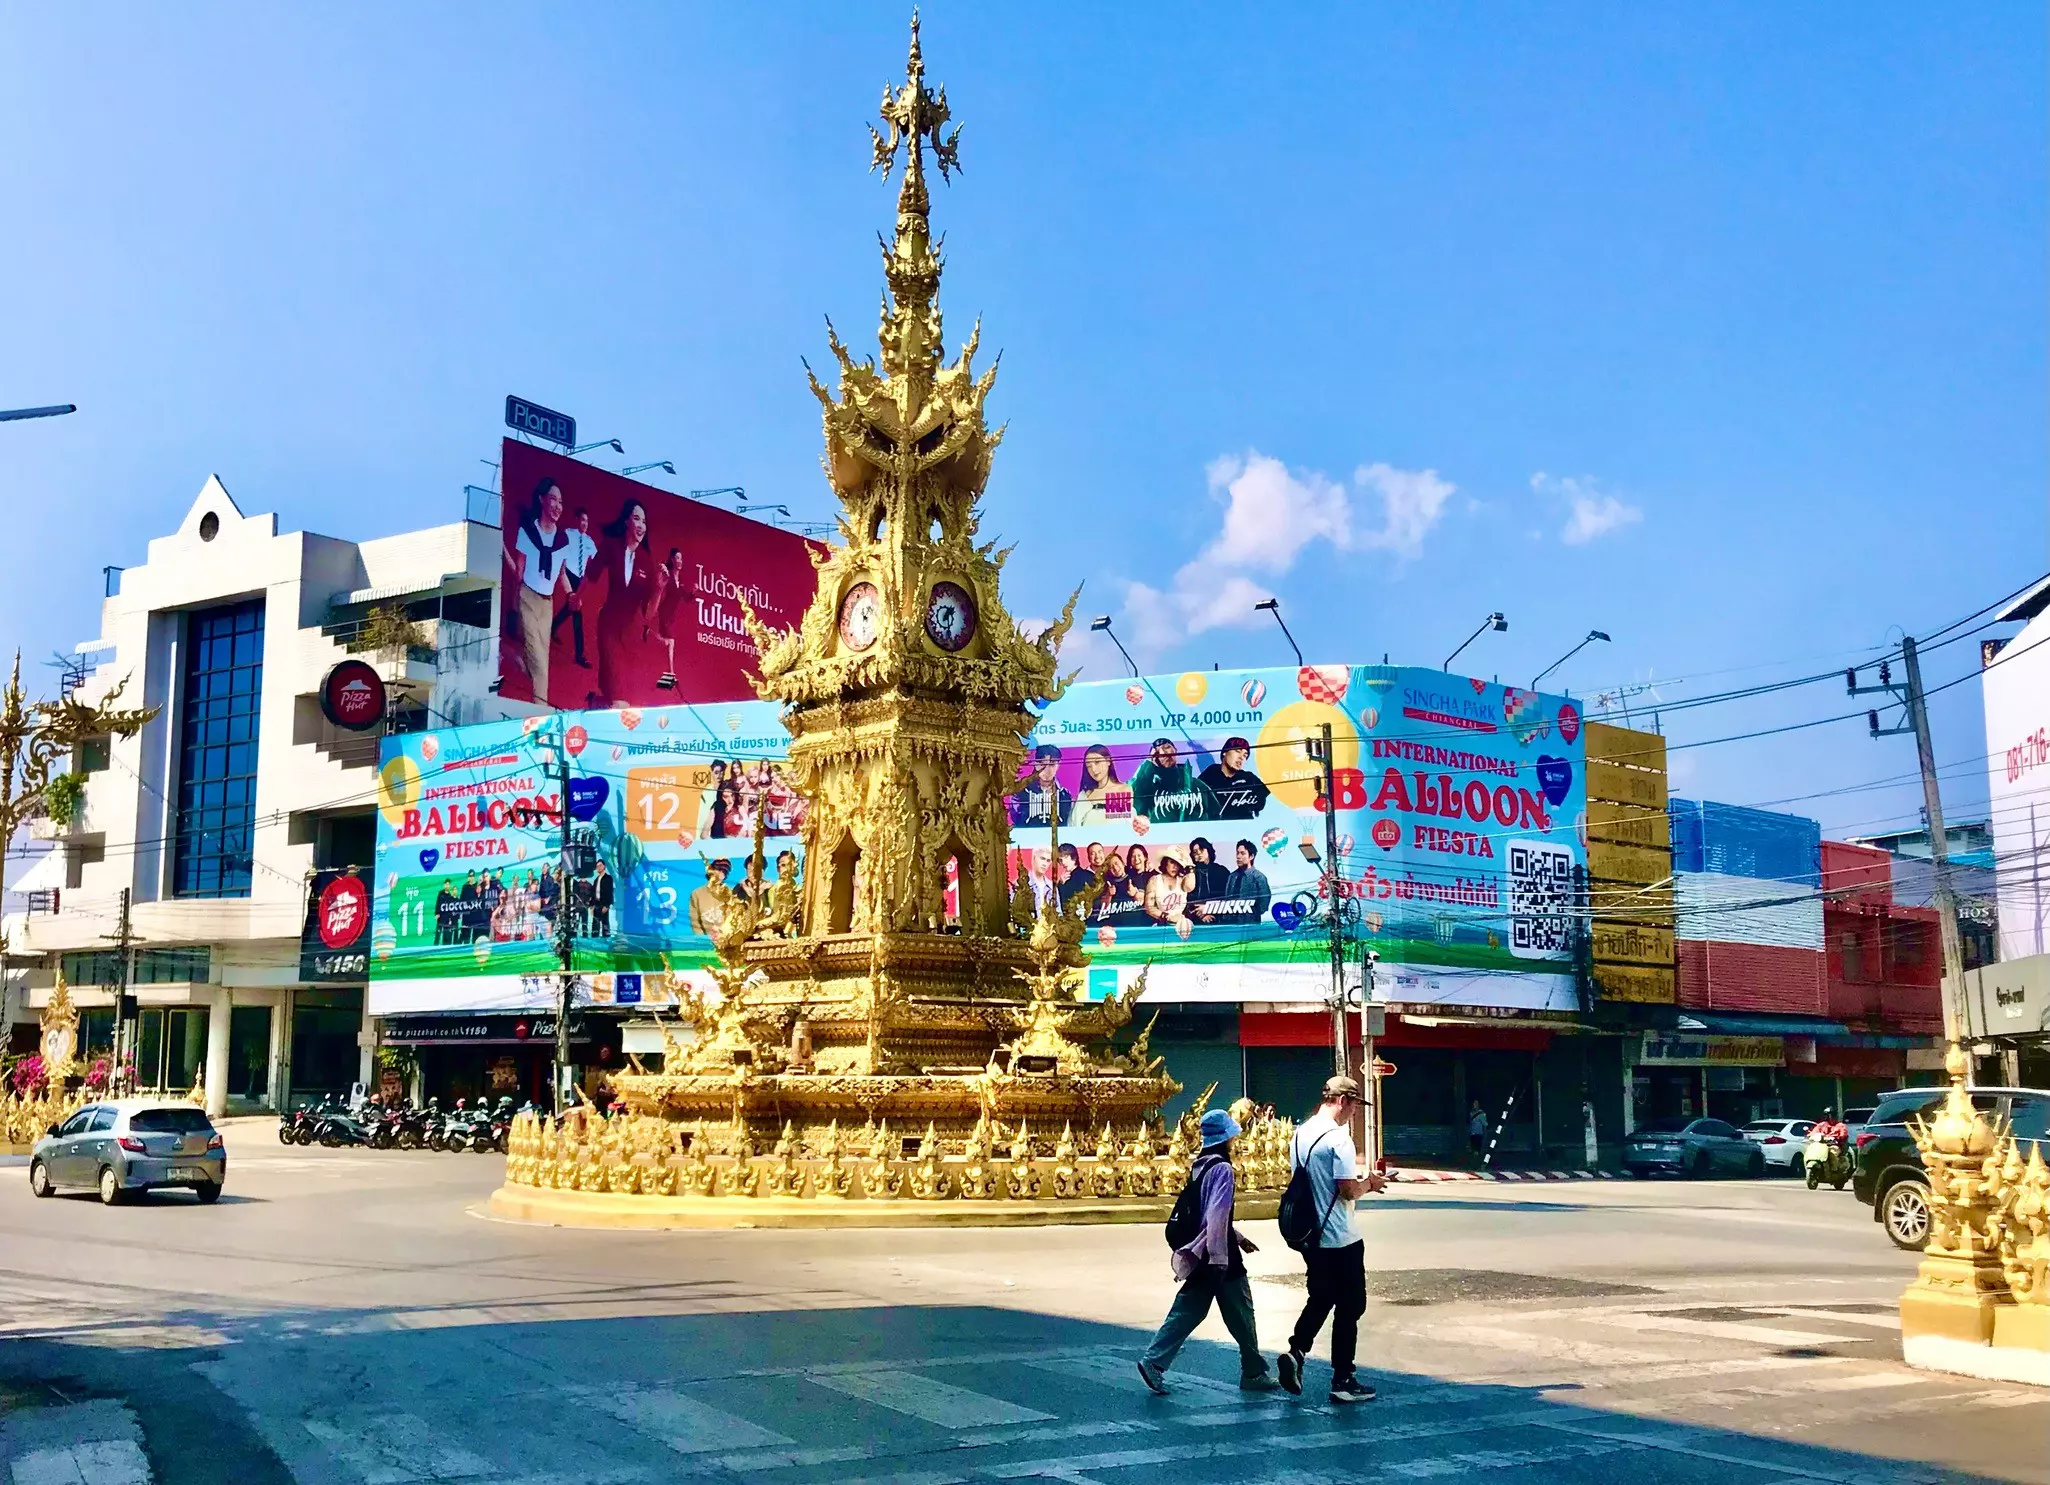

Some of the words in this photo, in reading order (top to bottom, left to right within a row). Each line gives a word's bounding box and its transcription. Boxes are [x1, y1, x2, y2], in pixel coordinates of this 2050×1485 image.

[345, 701, 368, 712] Hut
[1403, 687, 1459, 714] SINGHA
[1463, 700, 1496, 721] PARK
[1060, 720, 1092, 735] วันละ
[1096, 718, 1122, 732] 350
[1126, 717, 1152, 730] บาท
[1161, 713, 1186, 728] VIP
[1190, 710, 1232, 726] 4,000
[1236, 710, 1263, 723] บาท
[730, 736, 778, 751] เชียงราย
[1371, 739, 1520, 779] INTERNATIONAL
[425, 777, 536, 801] INTERNATIONAL
[1313, 767, 1552, 834] BALLOON
[397, 793, 563, 839] BALLOON
[638, 792, 681, 831] 12
[445, 838, 510, 860] FIESTA
[1379, 833, 1394, 841] LEO
[1413, 824, 1494, 859] FIESTA
[398, 900, 425, 937] 11
[636, 886, 678, 925] 13
[331, 917, 355, 936] Hut
[465, 1025, 488, 1036] 1150
